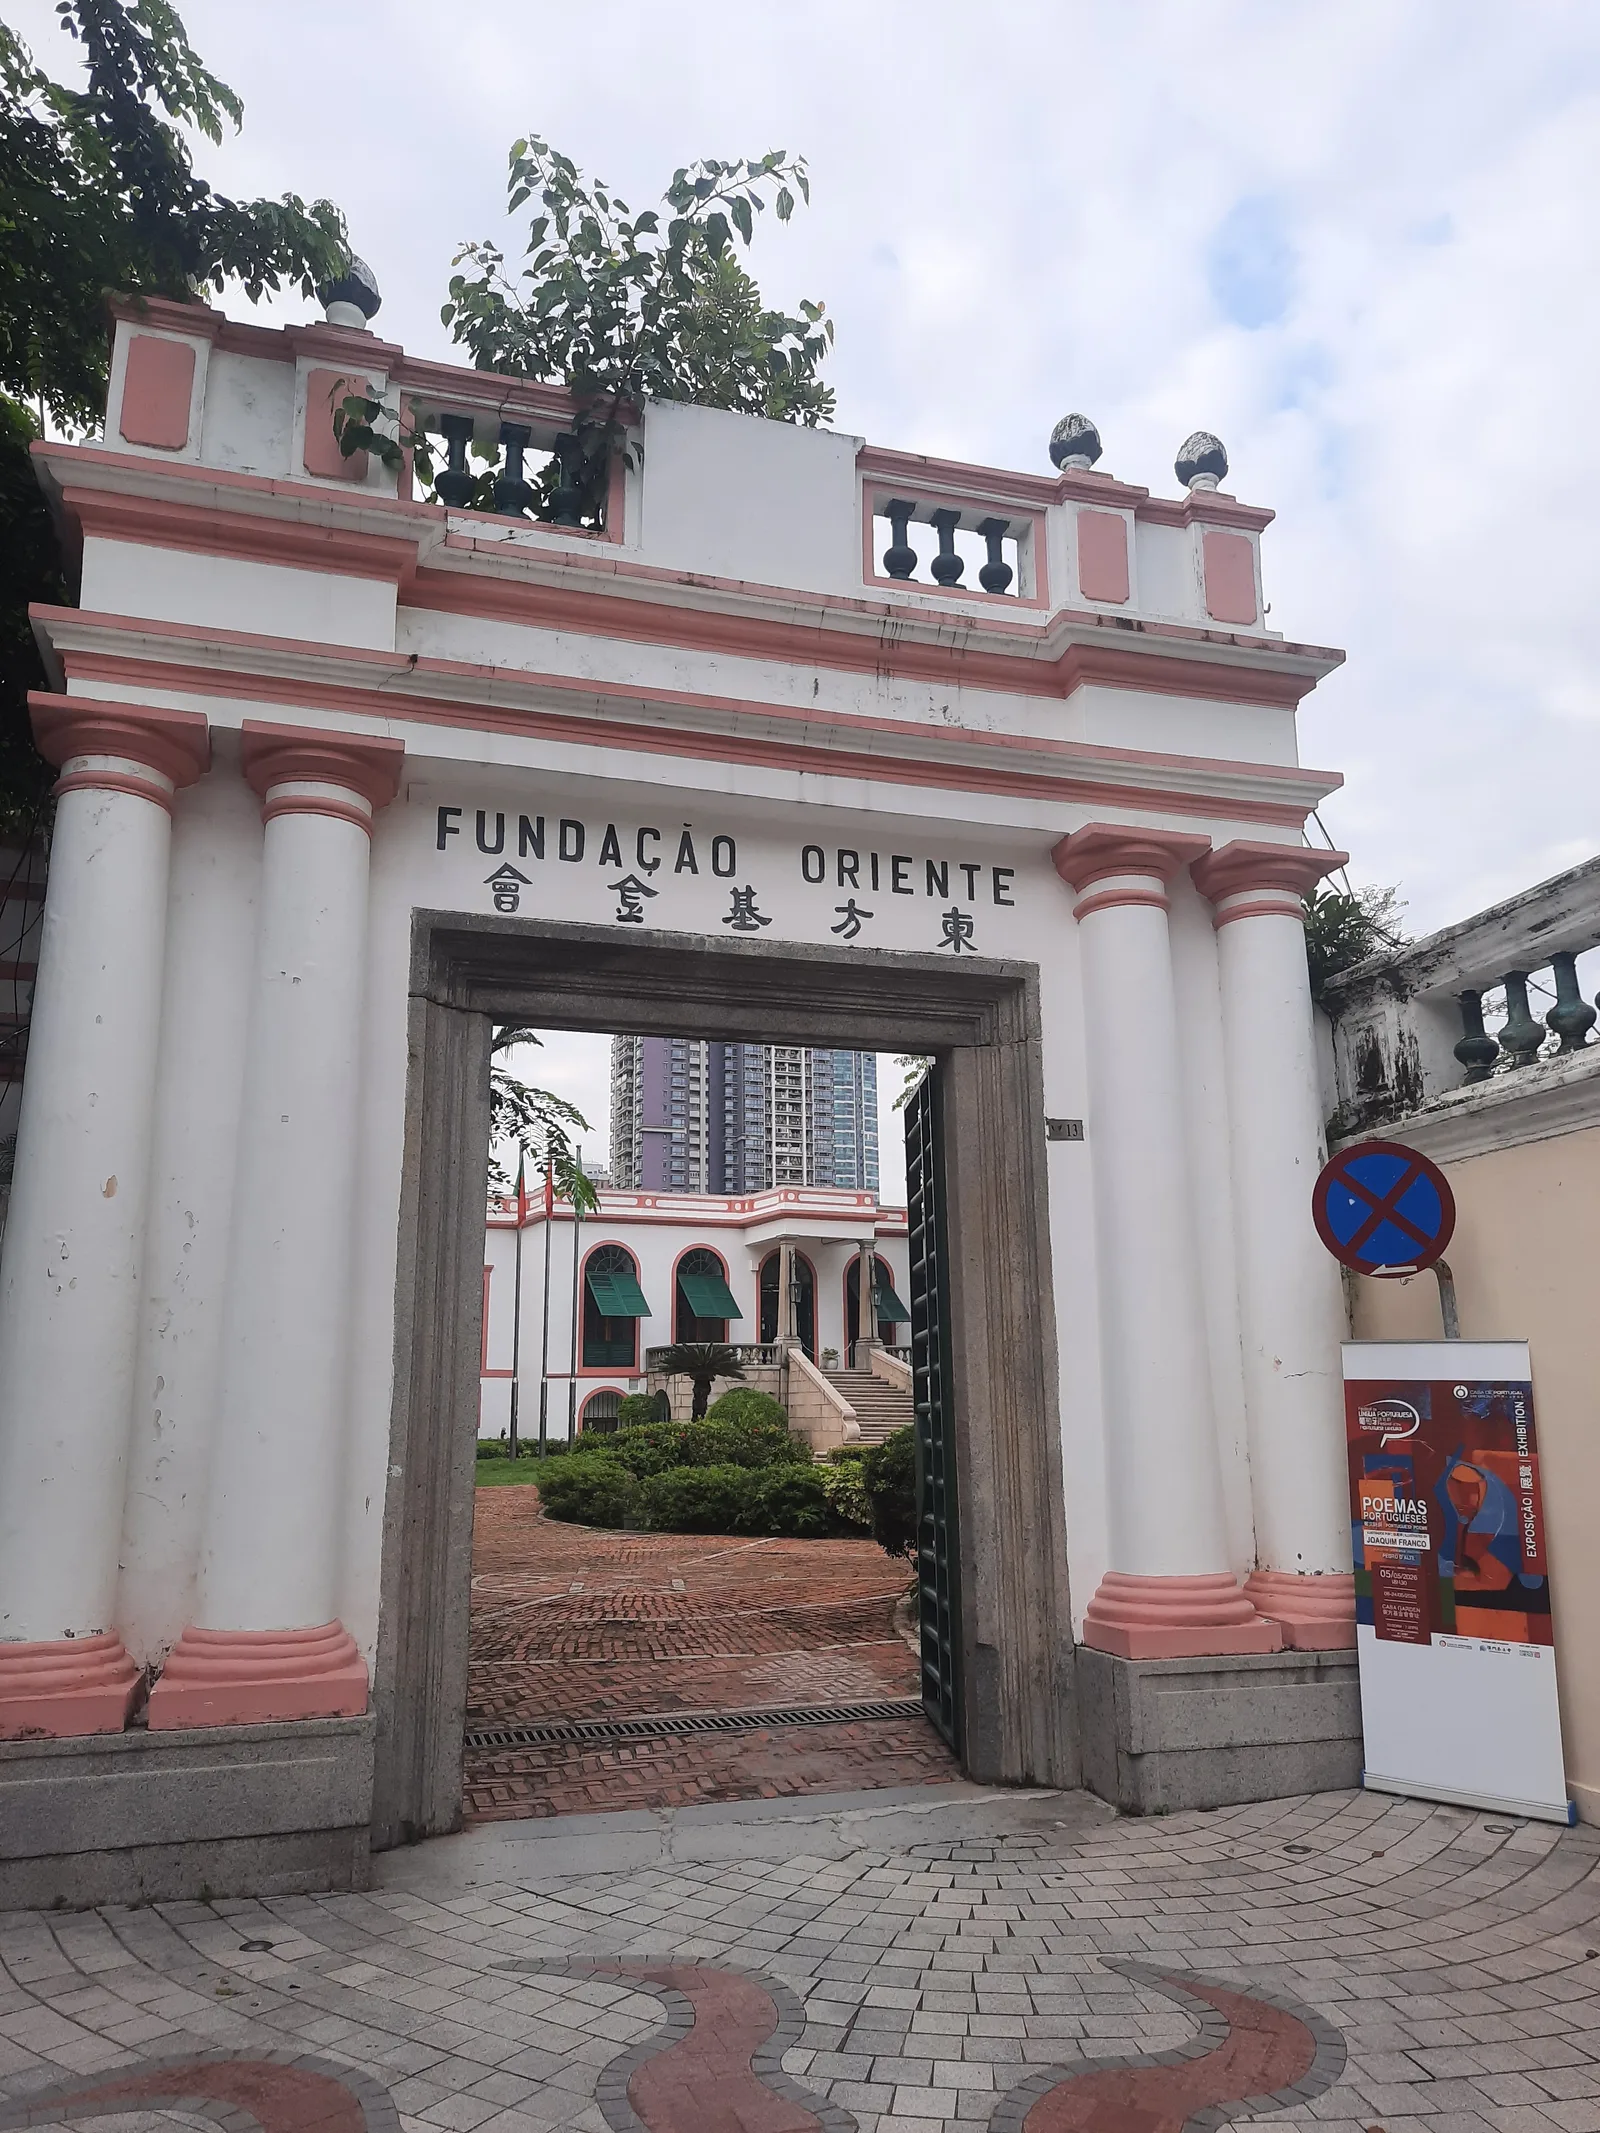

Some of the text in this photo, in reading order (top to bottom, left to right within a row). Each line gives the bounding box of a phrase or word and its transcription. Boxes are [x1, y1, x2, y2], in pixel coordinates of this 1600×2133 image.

[437, 807, 1017, 907] FUNDAÇÃO ORIENTE
[1066, 1123, 1078, 1137] 13
[1514, 1401, 1529, 1457] EXHIBITION
[1362, 1496, 1428, 1515] POEMAS
[1363, 1511, 1428, 1524] PORTUGUESES
[1521, 1497, 1537, 1558] EXPOSIÇÃO
[1366, 1536, 1427, 1548] JOAQUIM FRANCO
